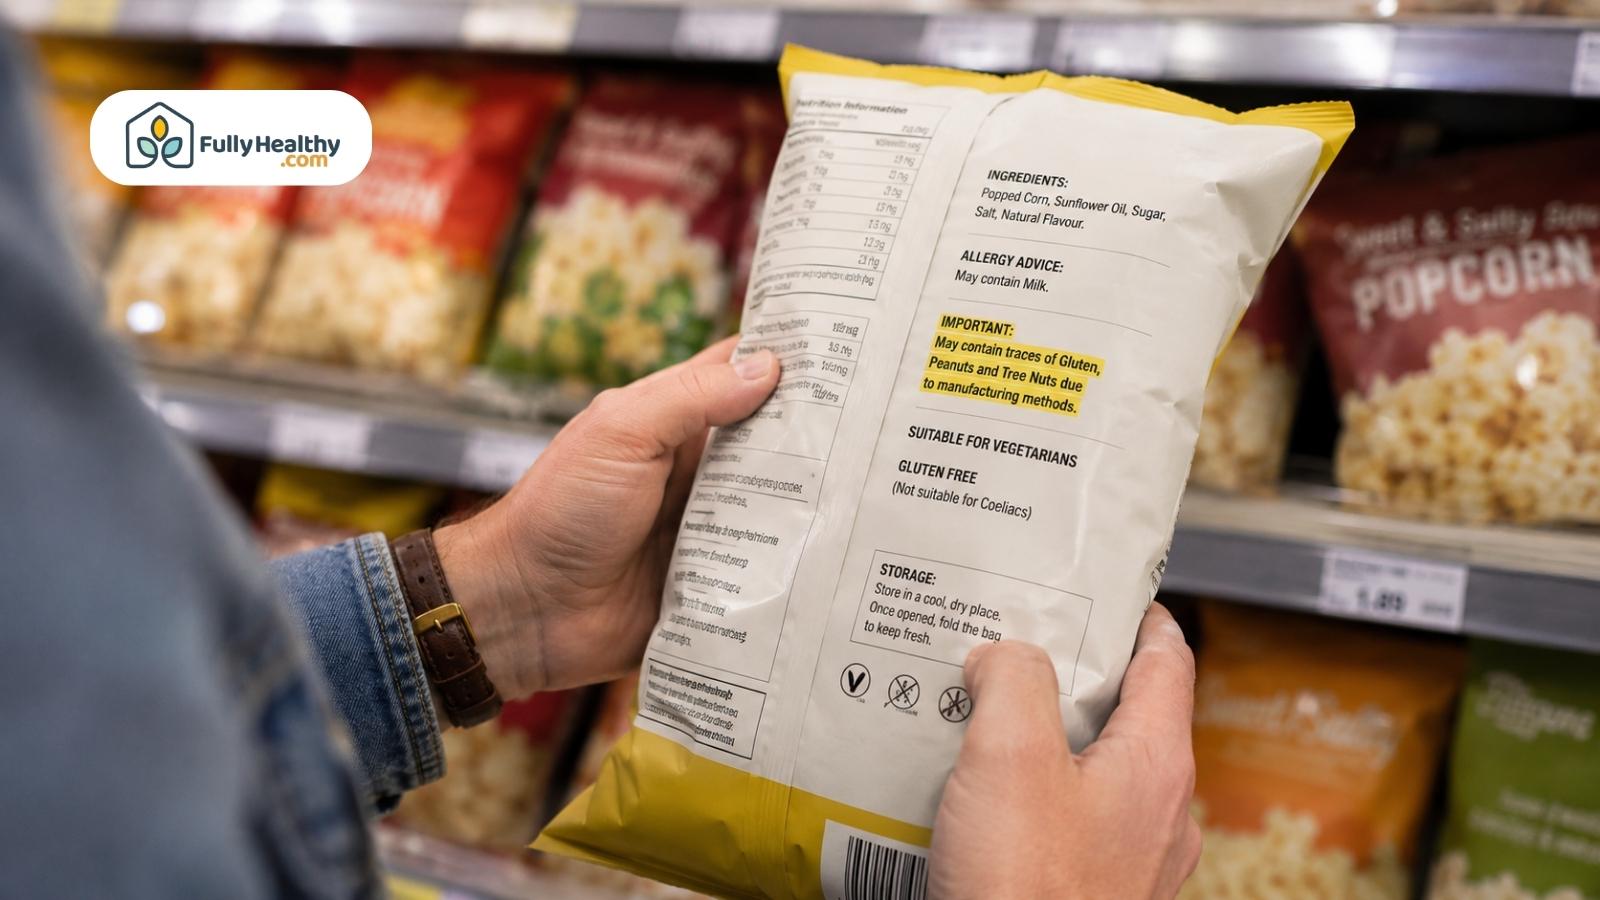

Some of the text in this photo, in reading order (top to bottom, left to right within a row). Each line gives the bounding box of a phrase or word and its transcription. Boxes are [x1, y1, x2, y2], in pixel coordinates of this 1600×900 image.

[987, 170, 1069, 188] INGREDIENTS:
[975, 206, 1085, 229] Salt, Natural Flavour.
[981, 188, 1166, 222] Popped Corn, Sunflower Oil, Sugar,
[960, 250, 1063, 273] ALLERGY ADVICE:
[955, 270, 1049, 292] May contain Milk.
[1352, 236, 1594, 331] POPCORN
[940, 315, 1014, 337] IMPORTANT:
[934, 336, 1101, 376] May contain traces of Gluten,
[928, 357, 1083, 392] Peanuts and Tree Nuts due
[923, 377, 1077, 413] to manufacturing methods.
[908, 425, 1078, 467] SUITABLE FOR VEGETARIANS
[898, 460, 977, 484] GLUTEN FREE
[892, 480, 1032, 520] (Not suitable for Coeliacs)
[880, 563, 936, 586] STORAGE:
[874, 582, 1001, 621] Store in a cool, dry place.
[864, 620, 932, 645] to keep fresh.
[869, 601, 1001, 643] Once opened, fold the bag
